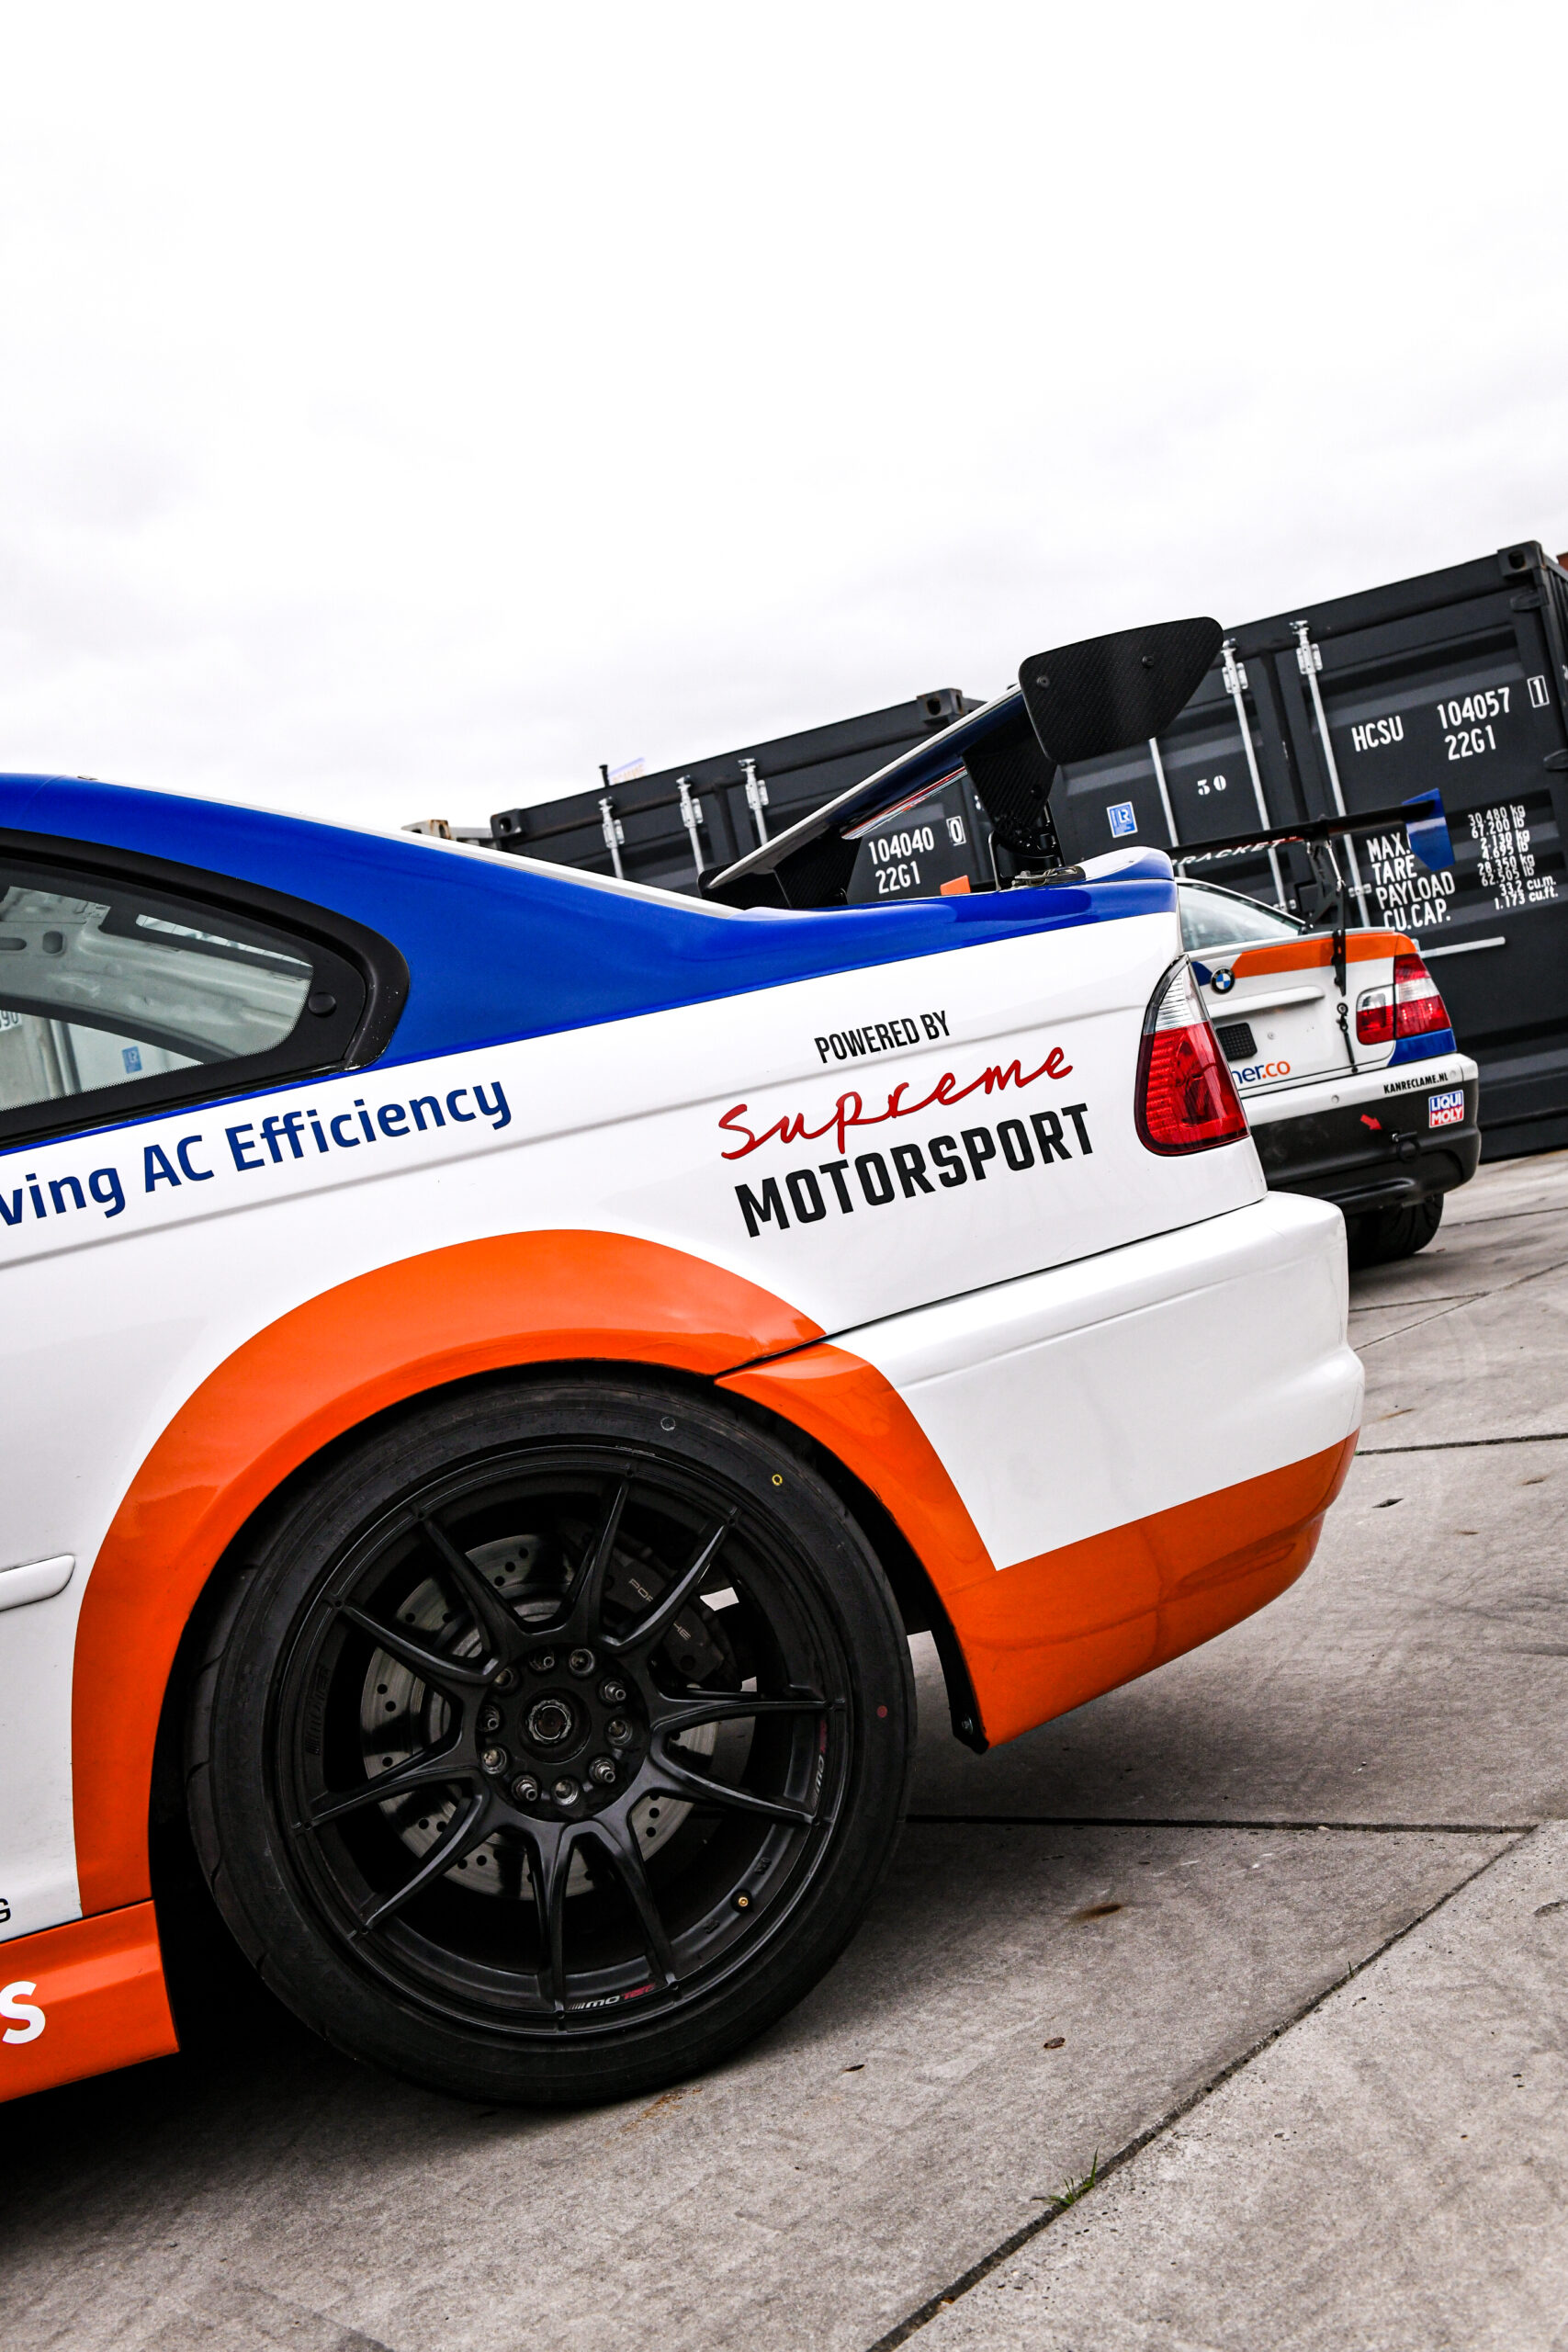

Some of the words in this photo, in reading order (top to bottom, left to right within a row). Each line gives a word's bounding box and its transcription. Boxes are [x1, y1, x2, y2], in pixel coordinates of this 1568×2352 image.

[1351, 715, 1404, 752] HCSU
[1437, 686, 1510, 729] 104057
[1444, 724, 1496, 761] 22G1
[1468, 806, 1508, 827] 30.480
[1510, 804, 1526, 819] kg
[1472, 818, 1510, 839] 67.200
[1512, 817, 1524, 829] lb
[868, 826, 935, 865] 104040
[1171, 838, 1286, 865] RACKET
[1366, 831, 1411, 863] MAX.
[1481, 831, 1513, 850] 2.130
[1516, 830, 1530, 842] kg
[1482, 842, 1515, 861] 4.695
[1517, 842, 1529, 853] lb
[874, 860, 921, 895] 22G1
[1371, 854, 1417, 886] TARE
[1477, 855, 1517, 876] 28.350
[1519, 853, 1536, 867] kg
[1481, 867, 1520, 888] 62.505
[1523, 865, 1534, 876] lb
[1375, 871, 1456, 910] PAYLOAD
[1494, 891, 1526, 910] 1.173
[1383, 898, 1451, 932] CU.CAP.
[814, 1018, 919, 1064] POWERED
[919, 1010, 951, 1041] BY
[1383, 1072, 1449, 1094] KANRECLAME.NL
[717, 1046, 1074, 1160] Supreme
[1431, 1092, 1461, 1112] LIQUI
[1431, 1106, 1463, 1125] MOLY
[143, 1135, 215, 1193] AC
[225, 1080, 513, 1173] Efficiency
[734, 1102, 1094, 1238] MOTORSPORT
